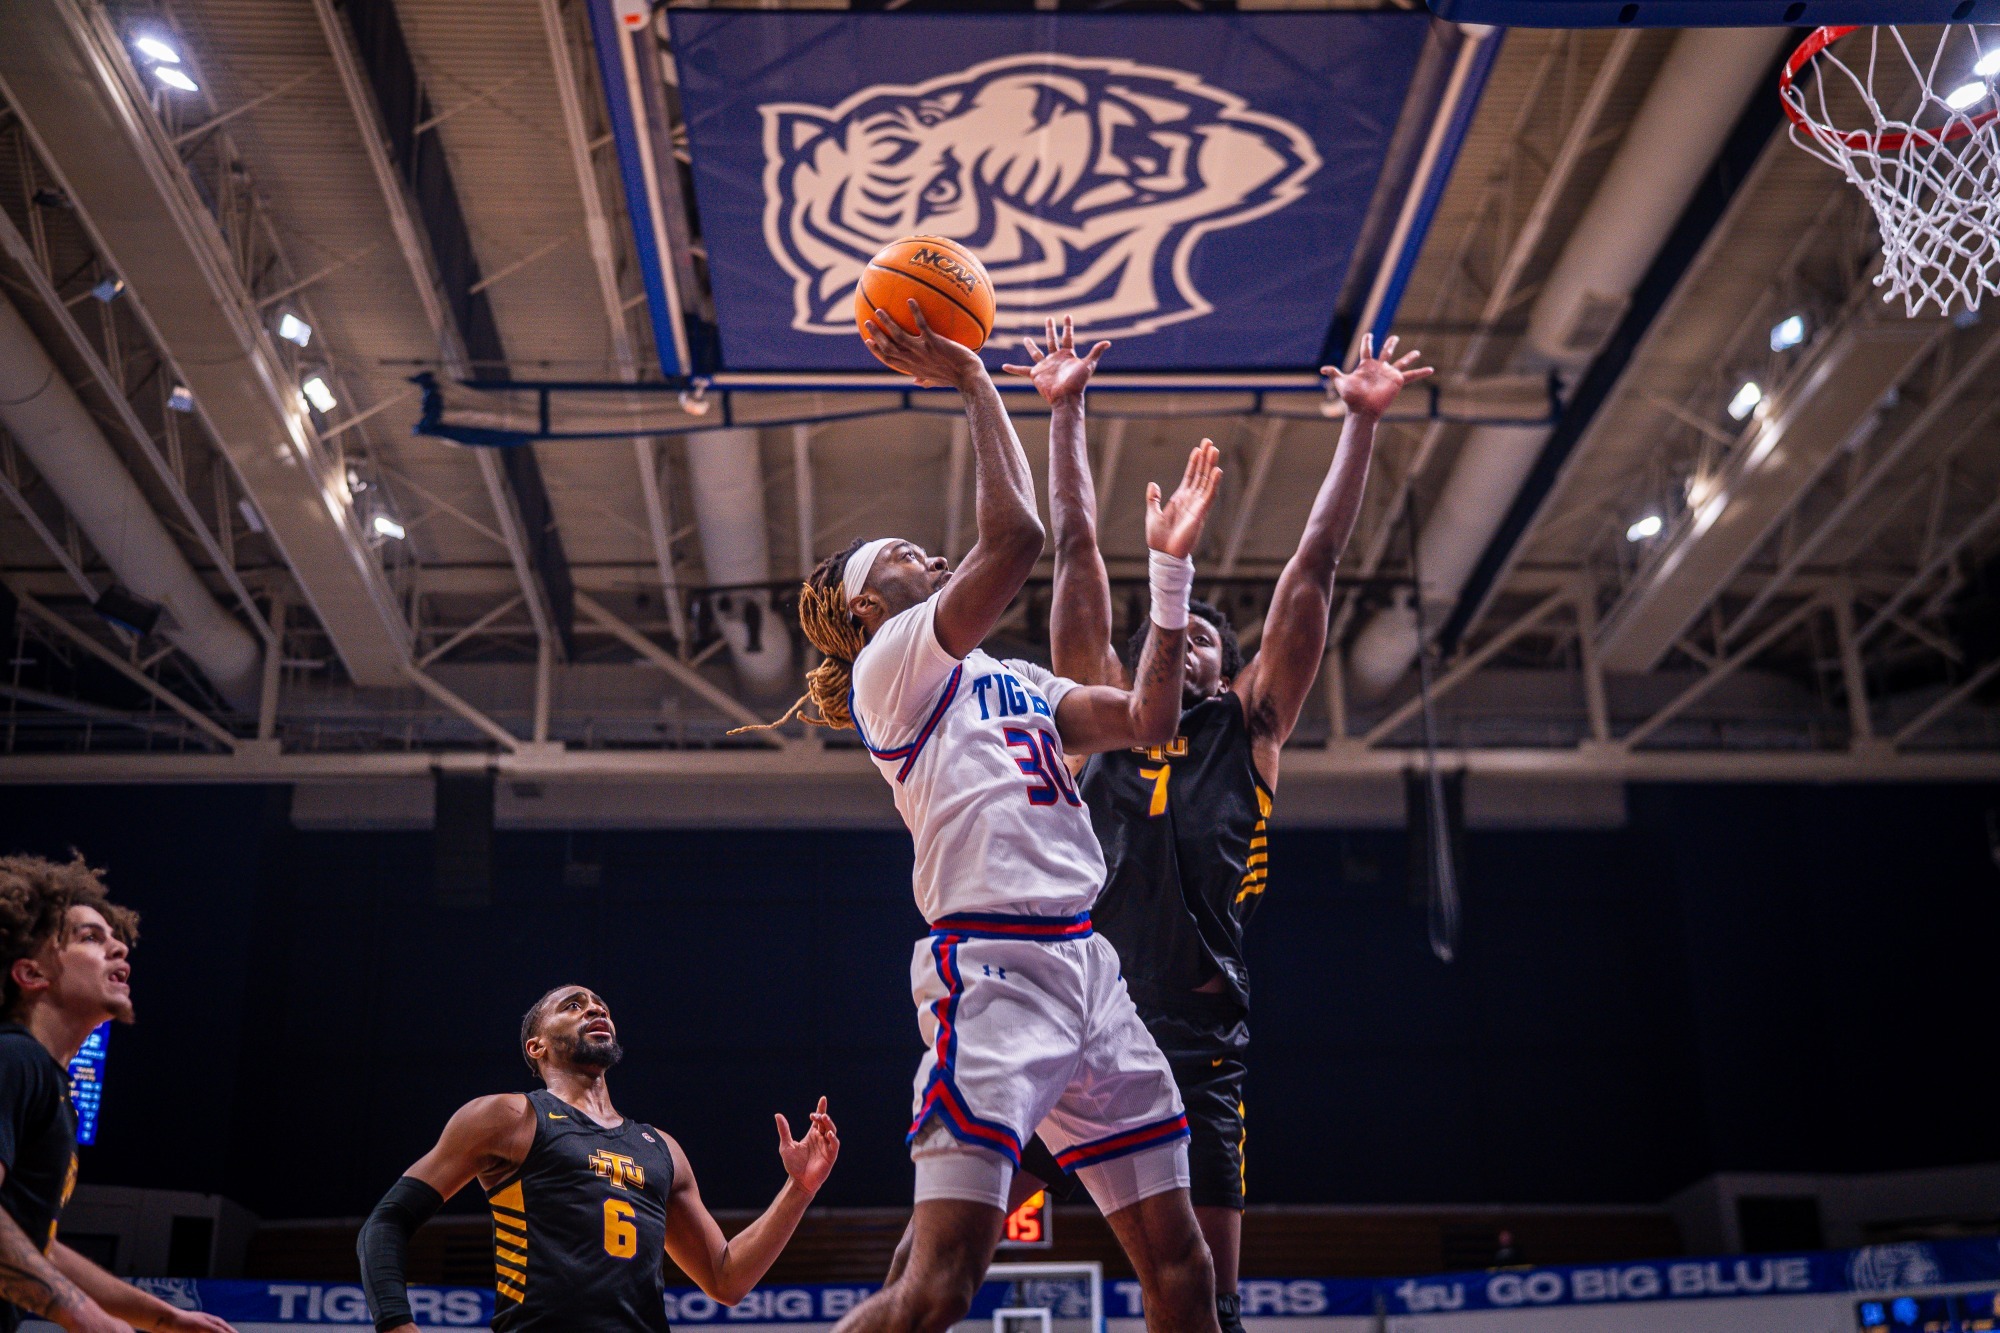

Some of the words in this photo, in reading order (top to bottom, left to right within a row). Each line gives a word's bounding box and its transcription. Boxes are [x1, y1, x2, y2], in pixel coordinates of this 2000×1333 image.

[910, 248, 977, 293] NCAA
[1003, 727, 1082, 807] 30
[1138, 764, 1171, 816] 7
[588, 1149, 645, 1190] TTU
[603, 1198, 637, 1260] 6
[268, 1284, 482, 1324] TIGRS
[1486, 1271, 1563, 1305] GO
[1571, 1265, 1659, 1299] BIG
[1668, 1257, 1809, 1295] BLUE
